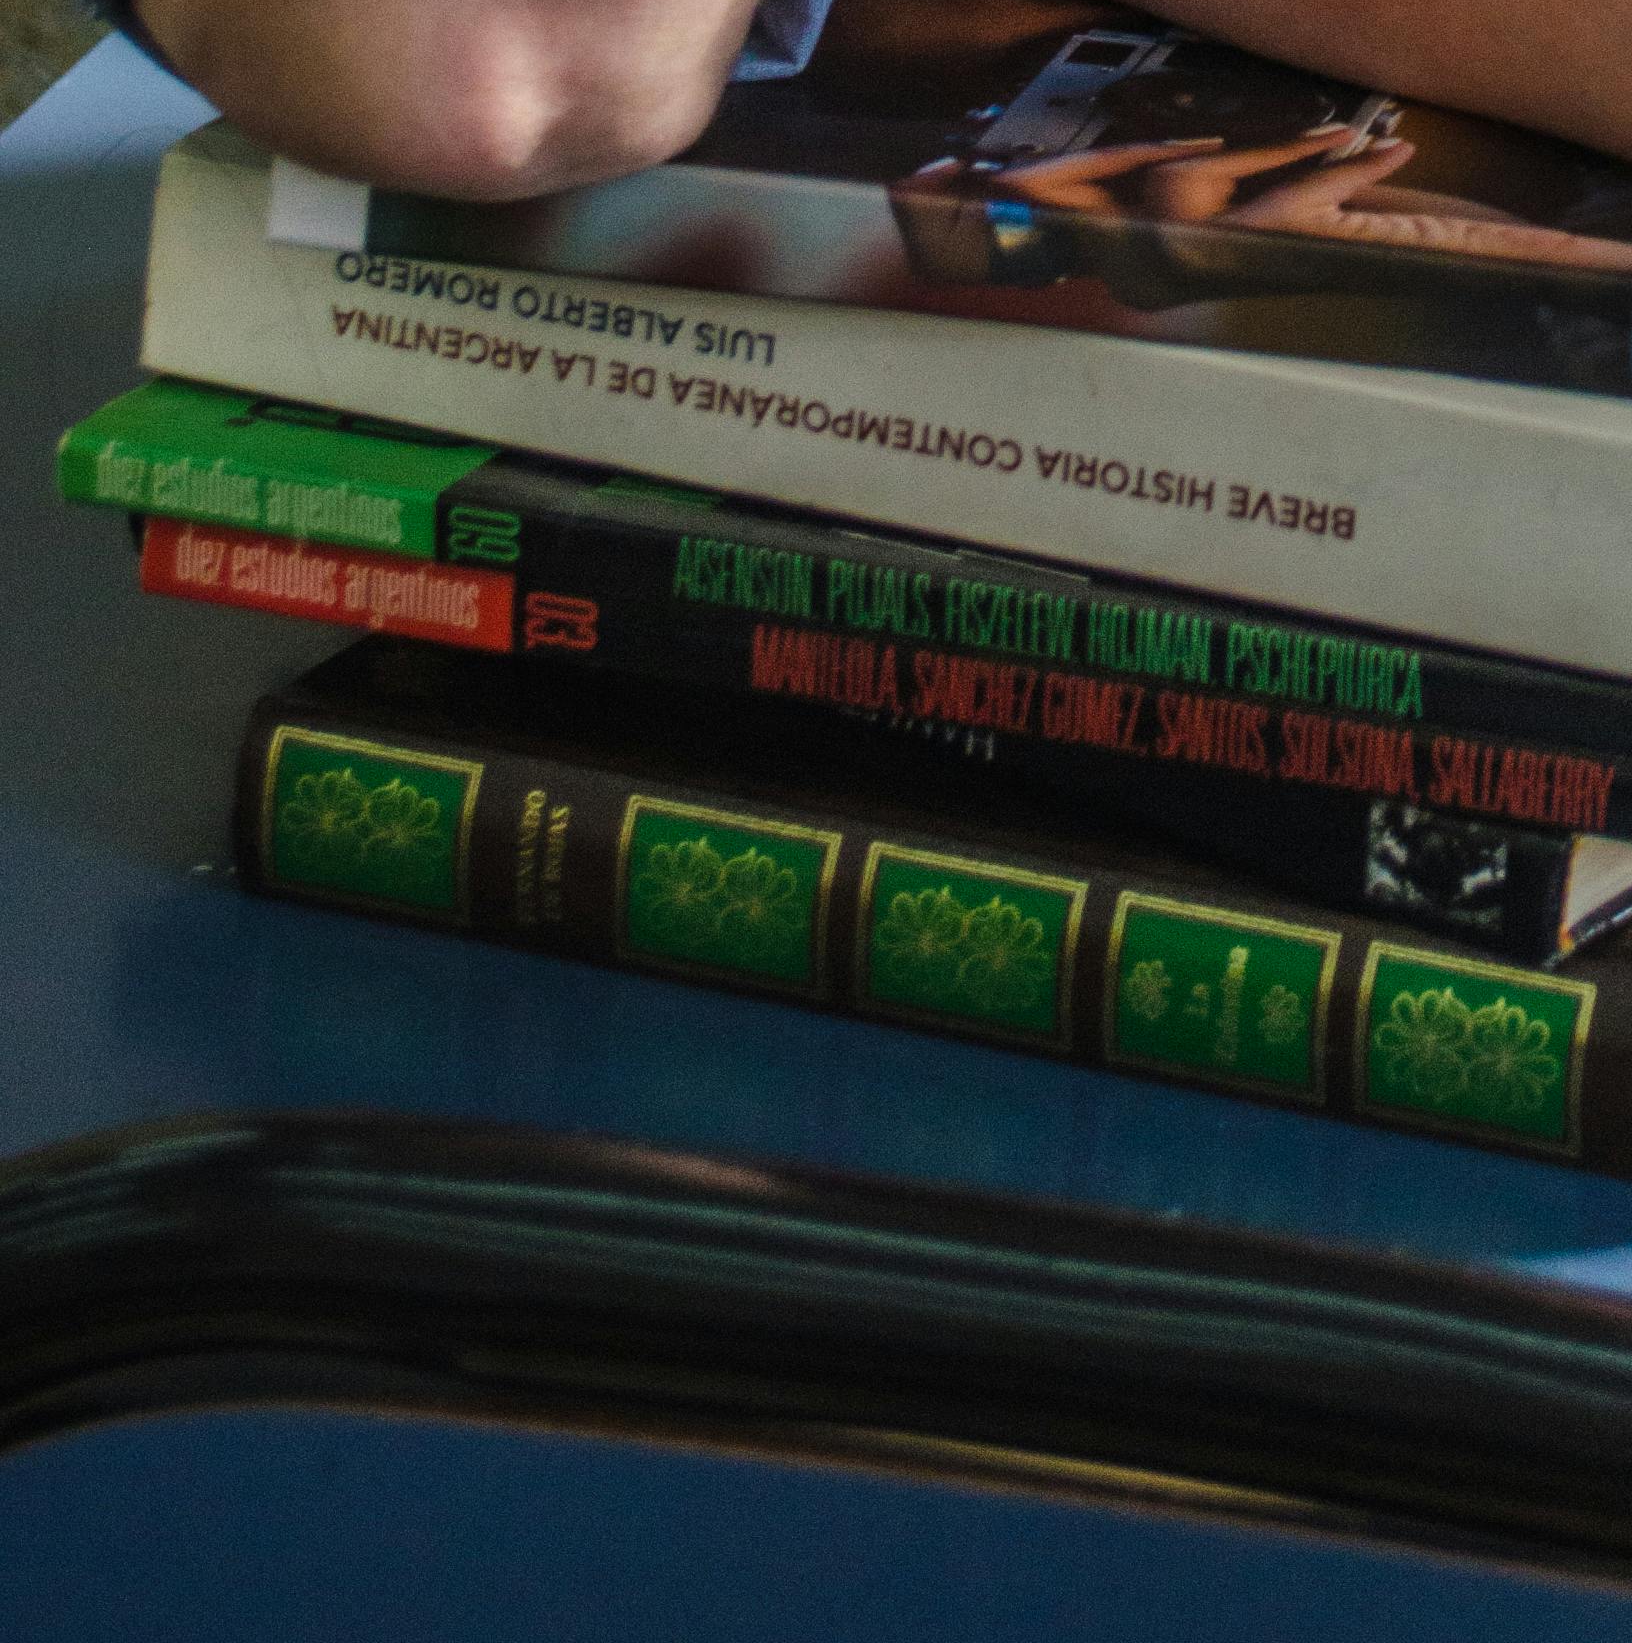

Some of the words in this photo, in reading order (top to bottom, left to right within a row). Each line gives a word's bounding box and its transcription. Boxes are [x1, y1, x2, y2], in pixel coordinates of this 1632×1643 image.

[335, 250, 500, 311] ROMERO
[331, 304, 542, 373] ARGENTINA
[511, 285, 684, 347] ALBERTO
[694, 321, 777, 366] LUIS
[550, 349, 597, 386] LA
[607, 360, 656, 399] DE
[668, 371, 1023, 472] CONTEMPORÁNEA
[95, 439, 144, 503] diez
[151, 458, 260, 521] estudios
[266, 479, 405, 552] argentinos
[1035, 444, 1217, 512] HISTORIA
[1227, 484, 1357, 540] BREVE
[175, 526, 223, 587] diez
[232, 541, 338, 606] estudios
[345, 562, 481, 631] argentinos
[1430, 734, 1614, 829] SALLABERRY
